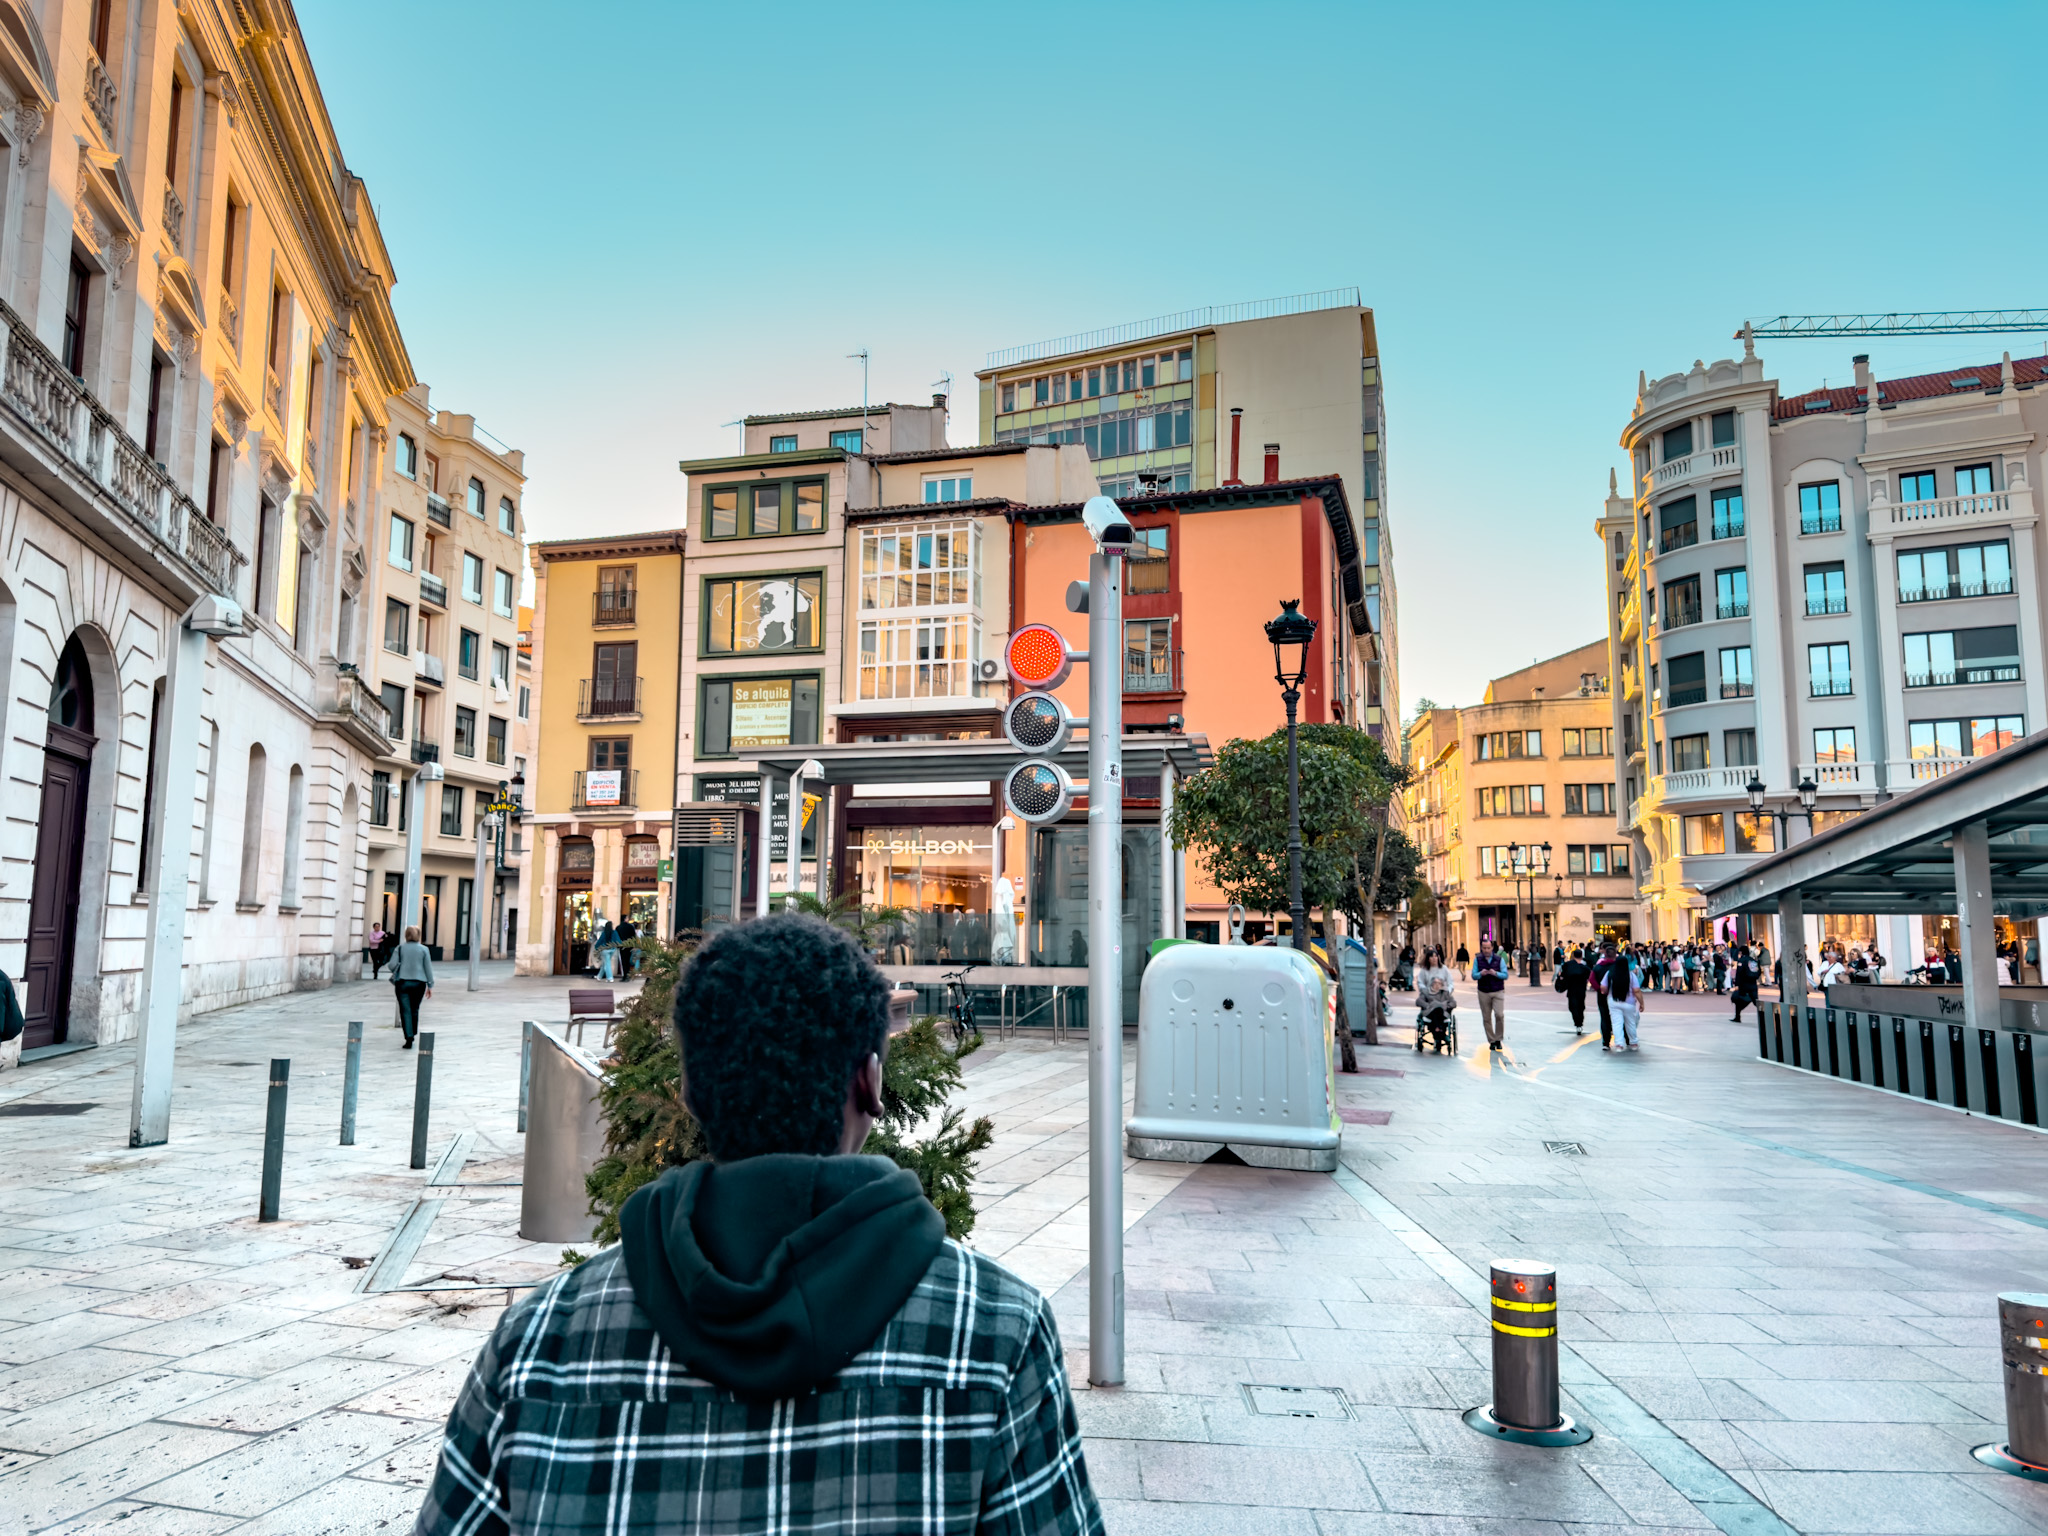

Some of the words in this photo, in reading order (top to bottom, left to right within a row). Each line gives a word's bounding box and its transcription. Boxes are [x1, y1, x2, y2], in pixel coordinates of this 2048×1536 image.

[735, 688, 749, 701] Se
[752, 687, 789, 702] alquila
[890, 839, 974, 855] SILBON
